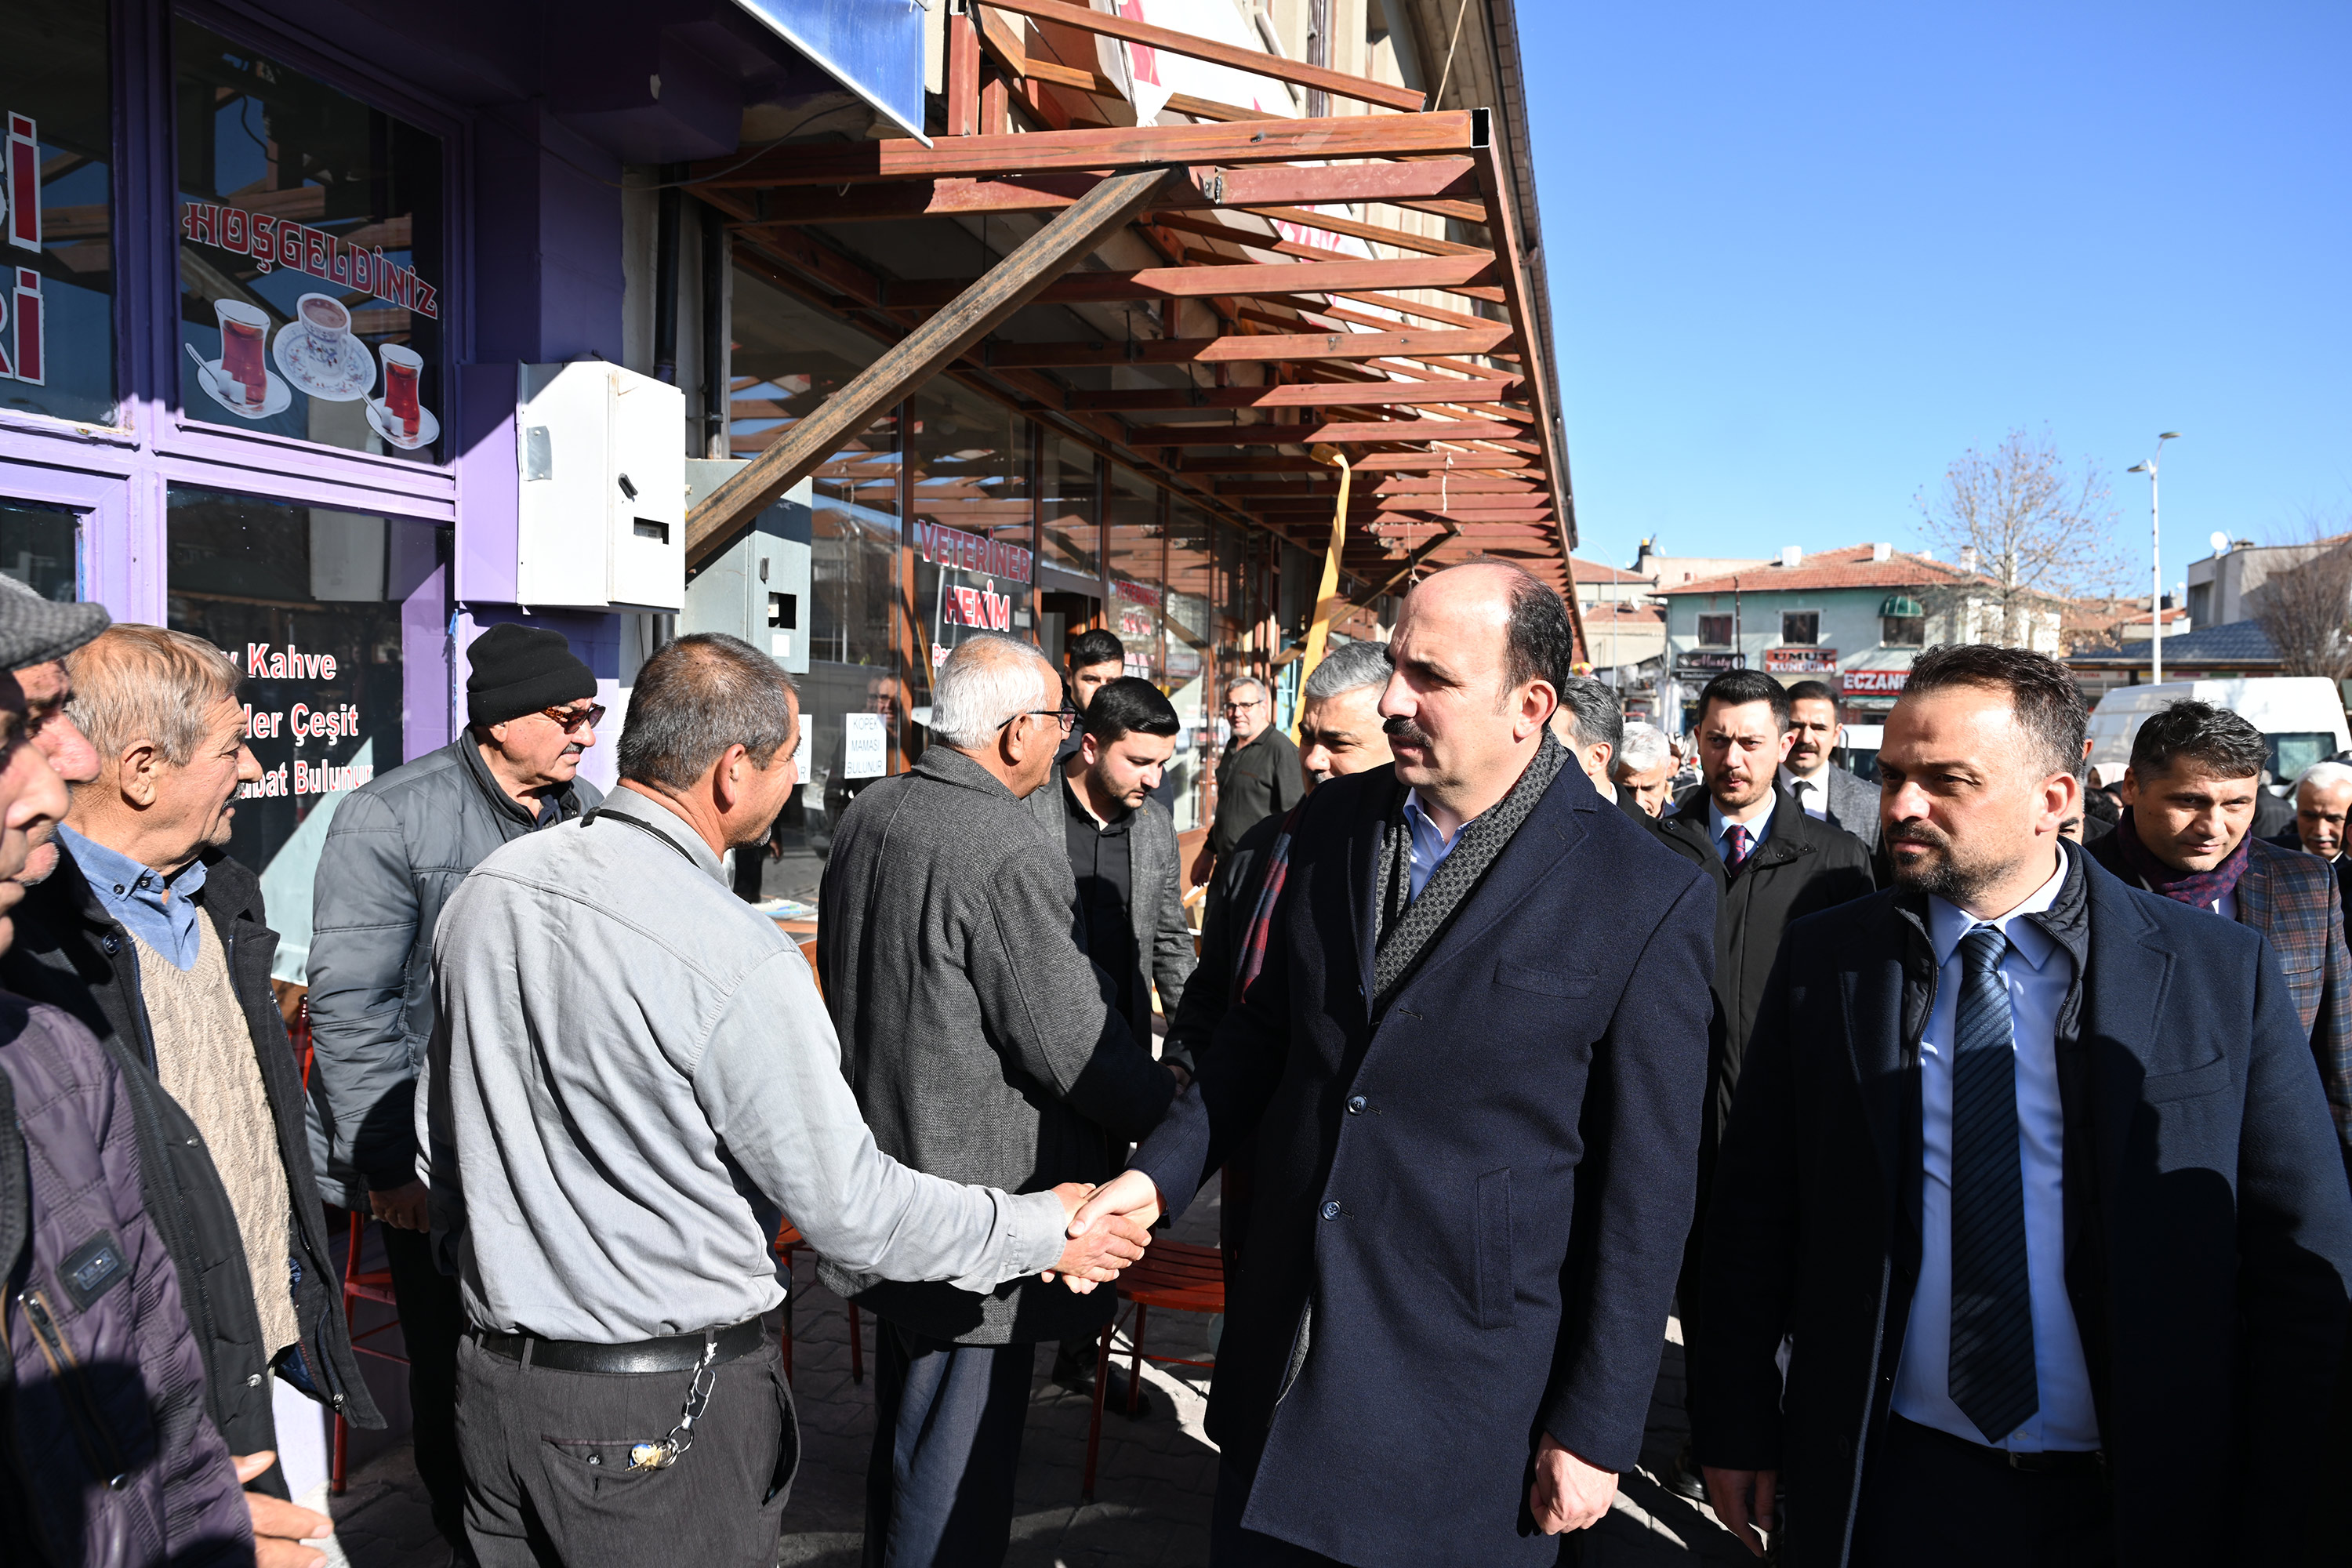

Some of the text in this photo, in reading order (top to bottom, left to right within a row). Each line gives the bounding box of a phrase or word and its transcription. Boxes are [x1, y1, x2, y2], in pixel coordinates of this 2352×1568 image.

[183, 201, 437, 320] HOŞGELDİNİZ
[918, 519, 1031, 584] VETERİNER
[944, 579, 1010, 632] HEKİM
[248, 643, 337, 680] Kahve
[1769, 662, 1835, 673] KUNDURA
[1773, 652, 1833, 661] UMUT
[290, 702, 359, 746] Çeşit
[294, 759, 374, 795] Bulunur
[847, 760, 883, 775] BULUNUR
